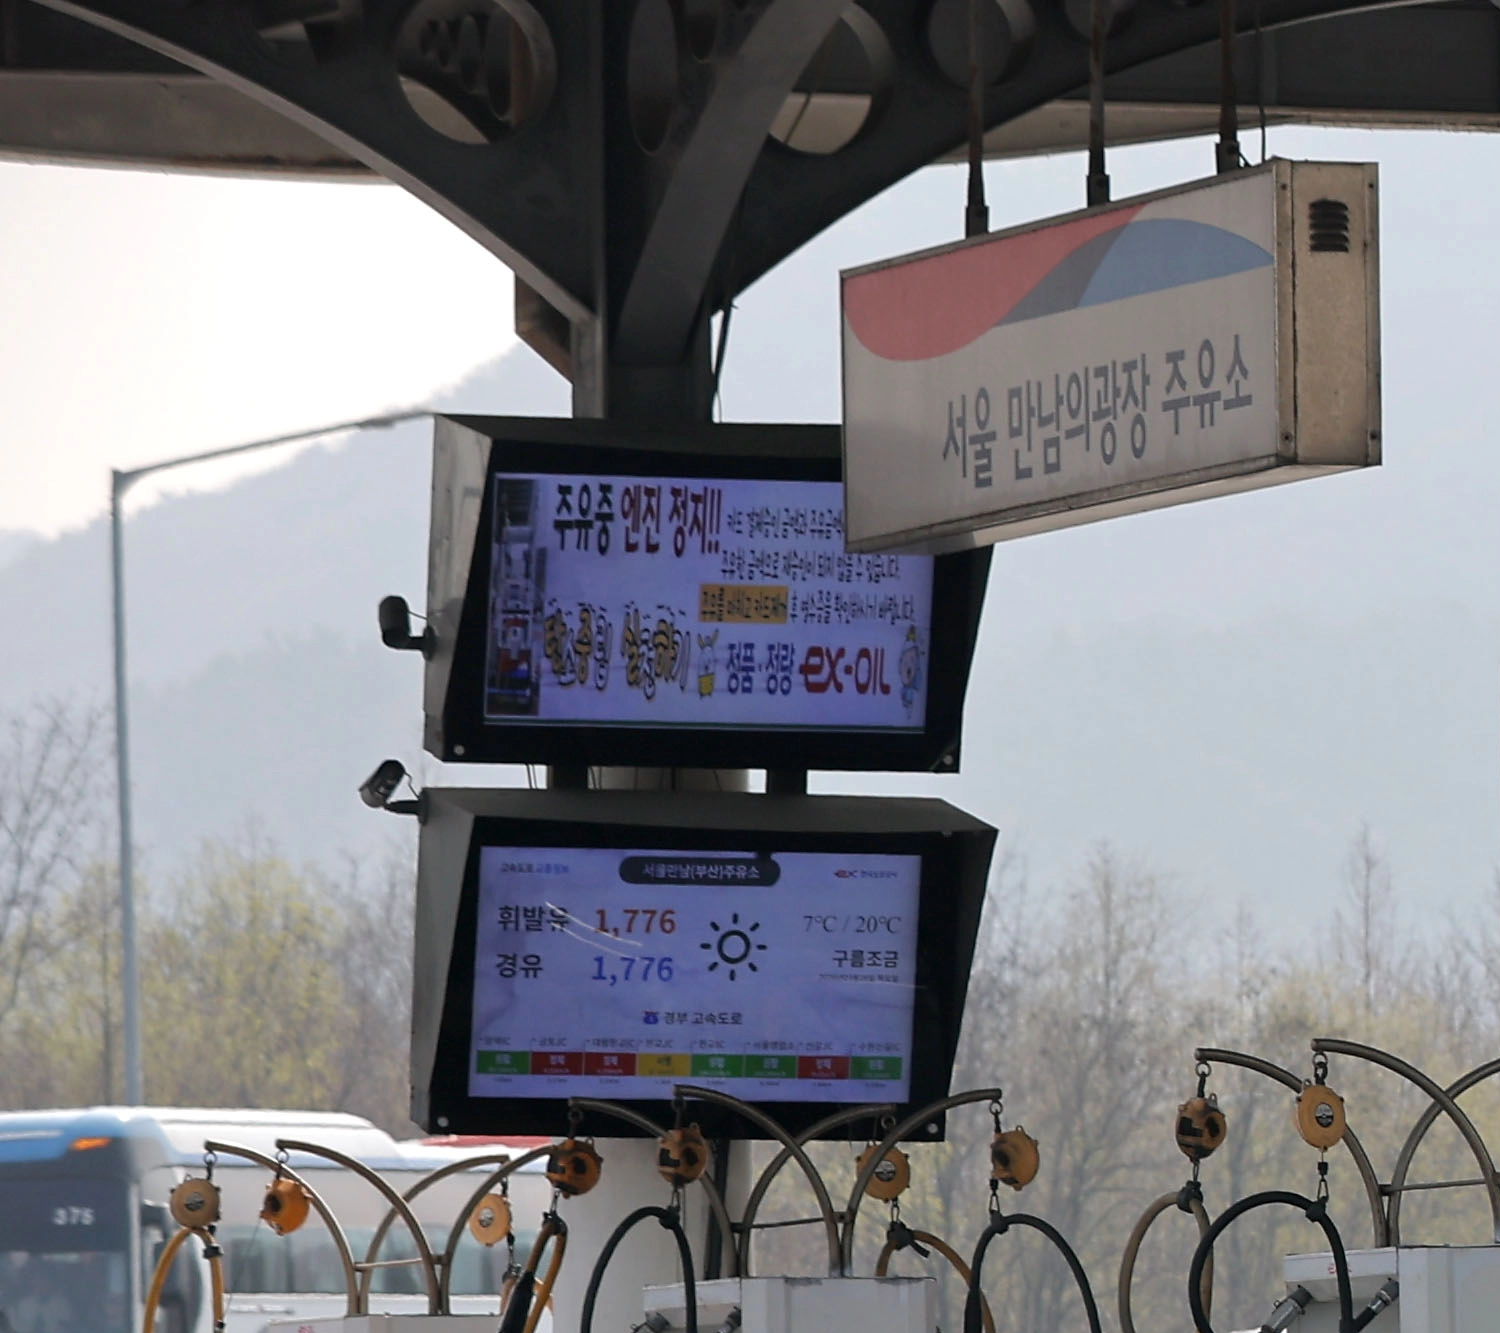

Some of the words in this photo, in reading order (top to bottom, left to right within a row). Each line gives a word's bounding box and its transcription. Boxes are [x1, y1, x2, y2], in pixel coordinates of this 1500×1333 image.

[942, 393, 996, 489] 서울
[1006, 346, 1150, 482] 만남의광장
[1160, 332, 1253, 439] 주유소
[553, 483, 615, 555] 주유중
[620, 484, 661, 554] 엔진
[497, 903, 571, 933] 휘발유
[594, 908, 678, 938] 1,776
[495, 952, 544, 980] 경유
[591, 955, 675, 987] 1,776
[831, 949, 900, 969] 구름조금
[691, 1012, 744, 1026] 고속도로
[54, 1206, 95, 1226] 375
